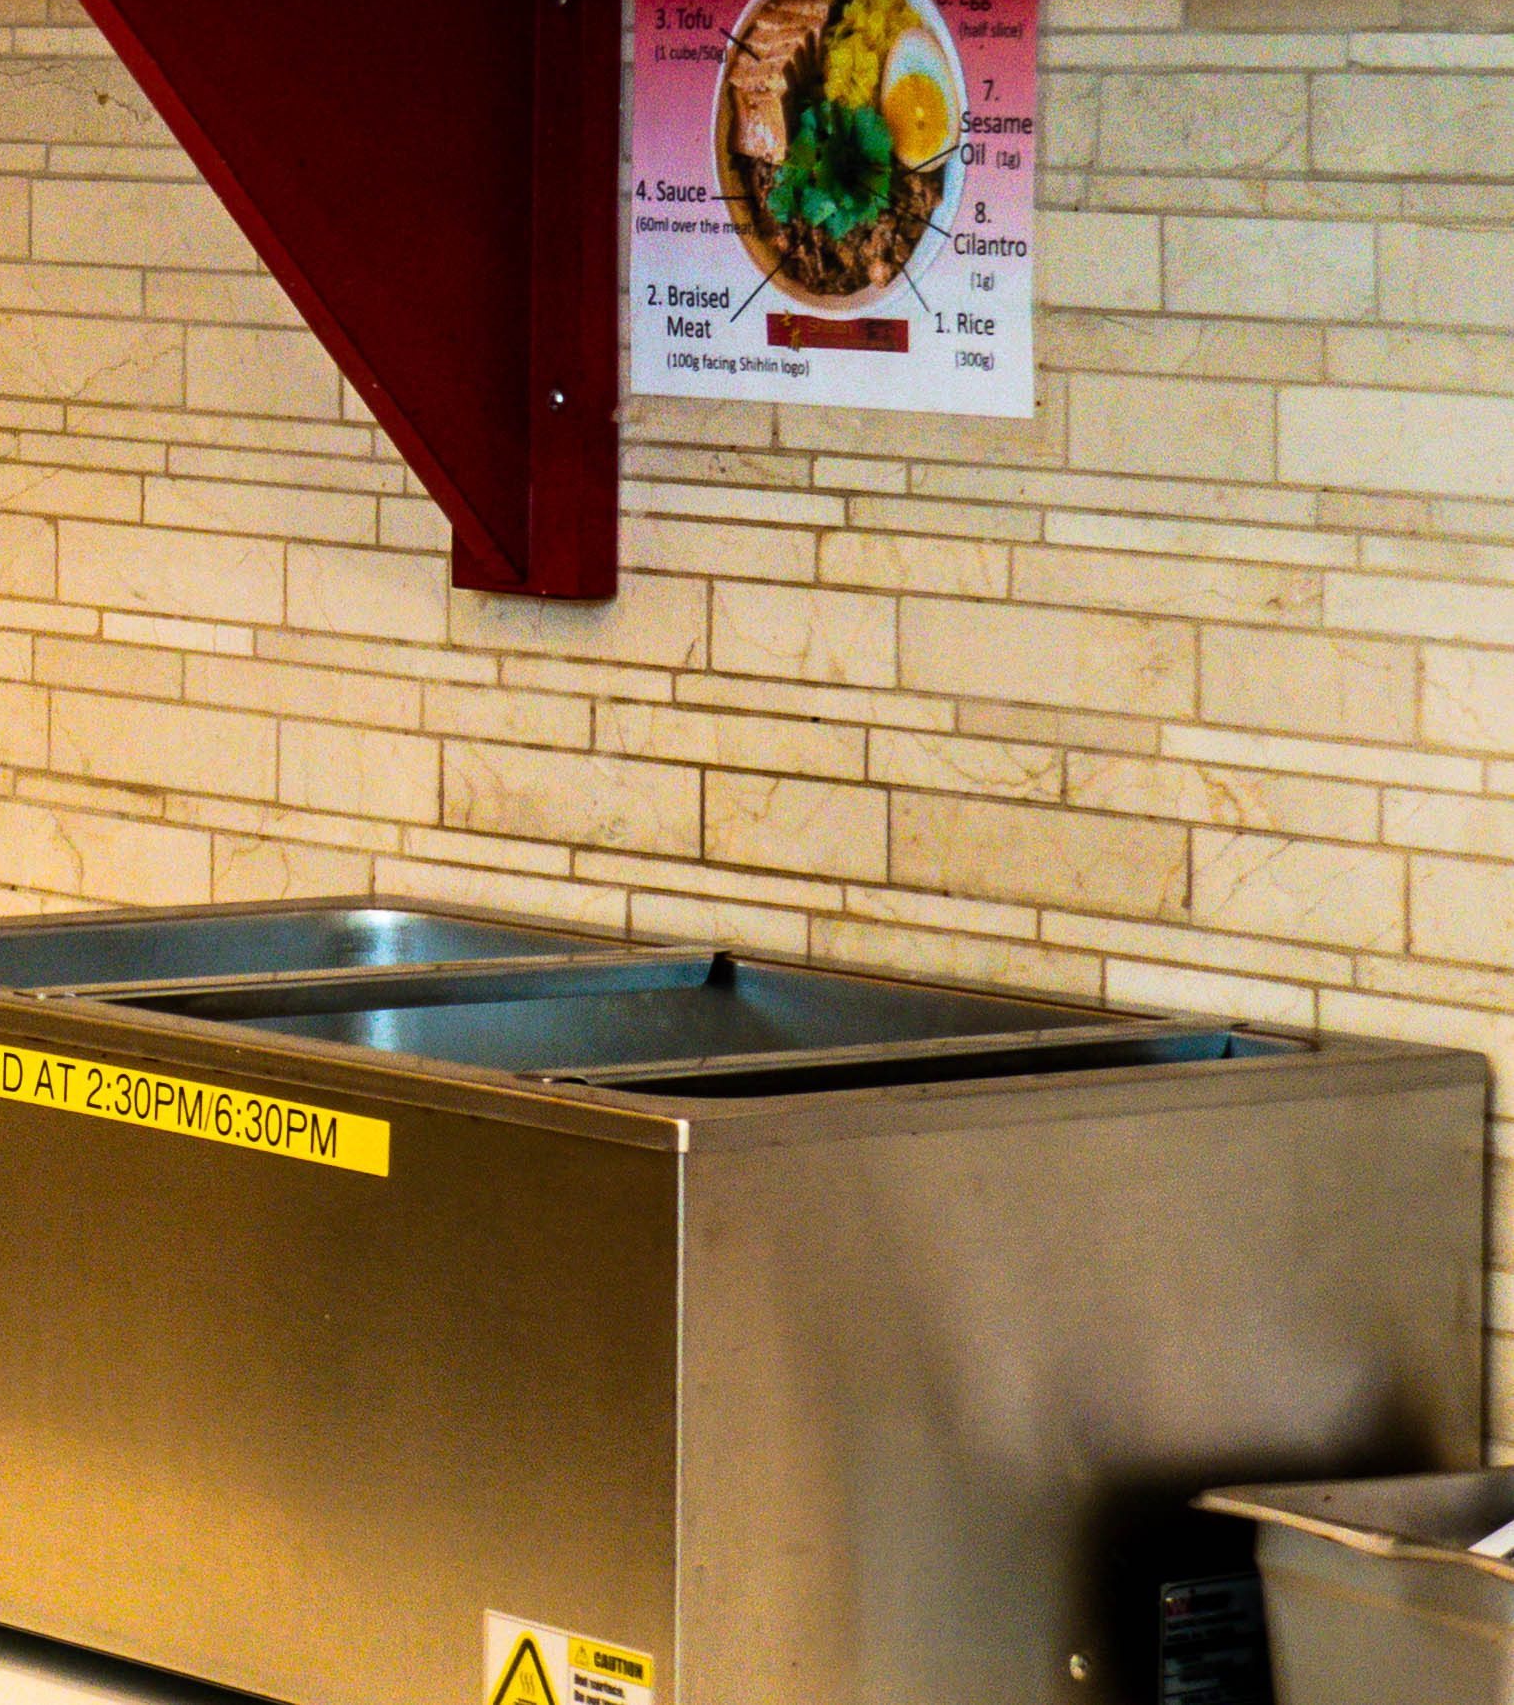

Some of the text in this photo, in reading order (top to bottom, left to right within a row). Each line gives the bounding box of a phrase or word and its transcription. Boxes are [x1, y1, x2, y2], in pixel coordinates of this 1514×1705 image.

[655, 6, 713, 30] 3. Tofu
[991, 21, 1023, 40] slice)
[982, 79, 999, 101] 7.
[960, 111, 1033, 134] Sesame
[960, 143, 1021, 170] Oil (1g)
[636, 180, 707, 203] 4. Sauce
[974, 202, 991, 224] 8.
[636, 216, 669, 235] (60ml
[671, 221, 696, 234] over
[699, 218, 719, 234] the
[954, 233, 1028, 257] Cilantro
[971, 273, 995, 291] (1g)
[647, 285, 730, 309] 2. Braised
[667, 317, 711, 339] Meat
[935, 312, 995, 336] 1. Rice
[667, 352, 810, 377] (100g facing Shihlin logo)
[955, 352, 995, 371] (300g)
[35, 1059, 76, 1103] AT
[85, 1067, 338, 1159] 2:30PM/6:30PM
[594, 1651, 643, 1680] CAUTION
